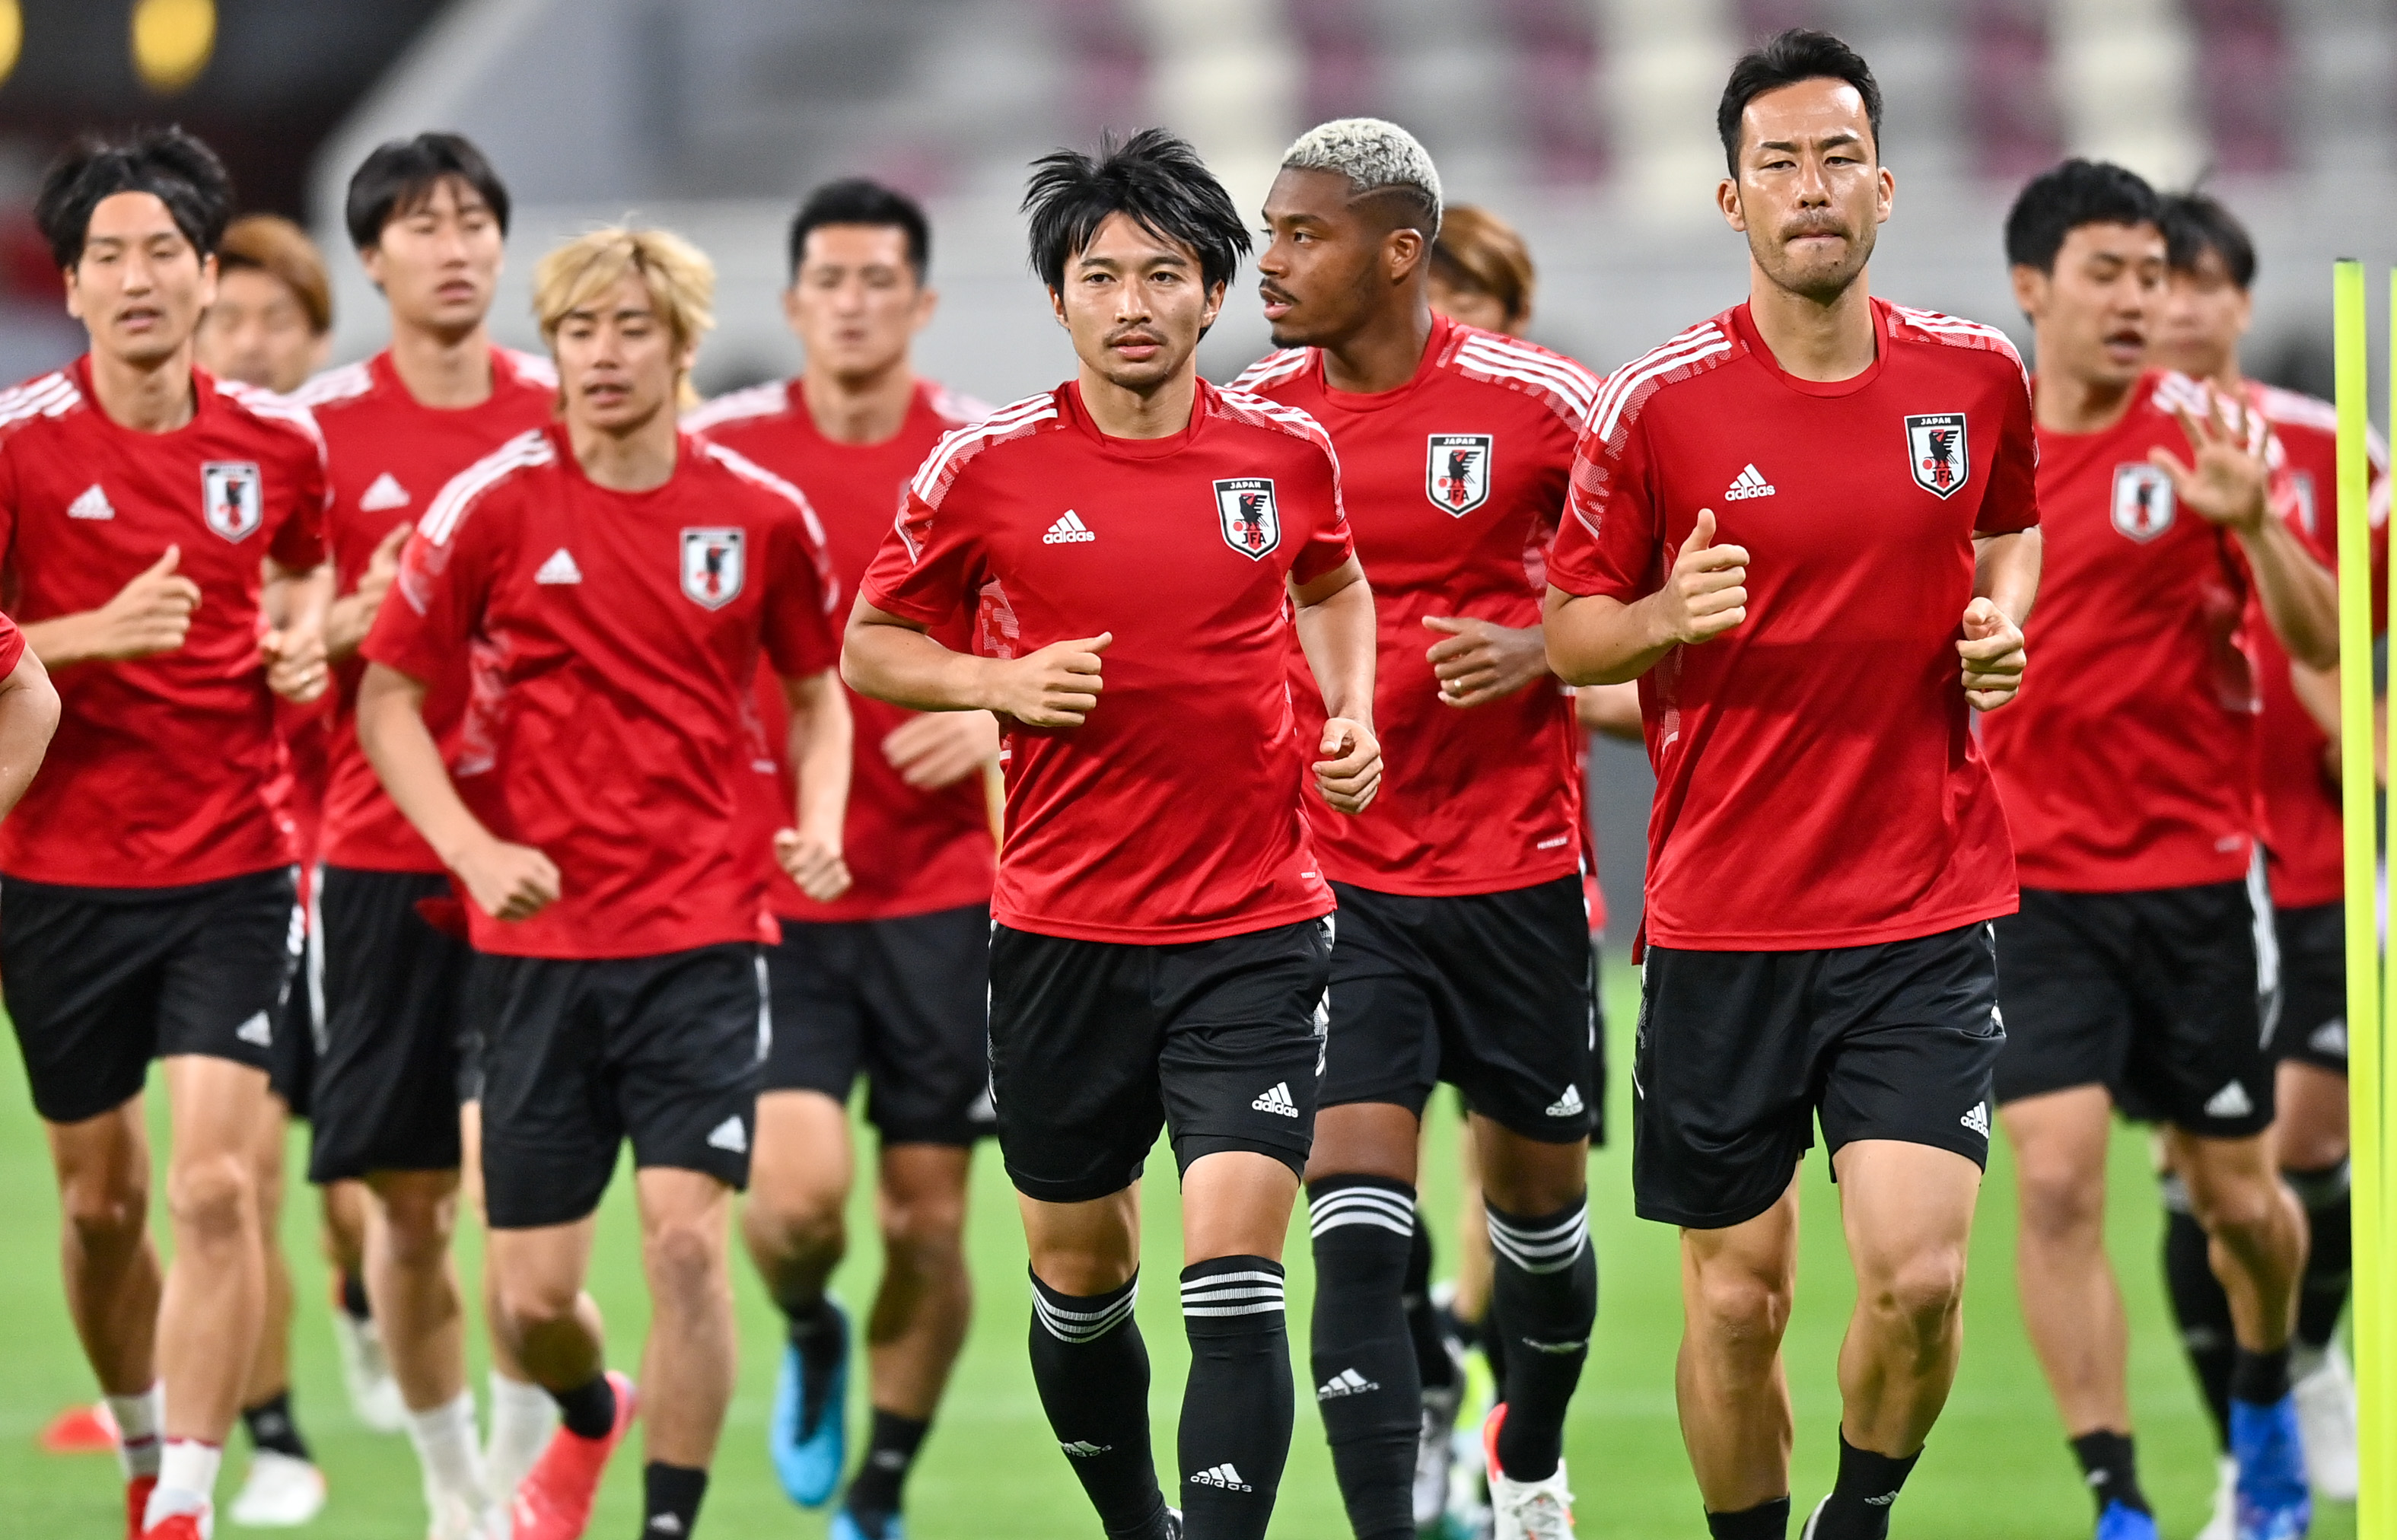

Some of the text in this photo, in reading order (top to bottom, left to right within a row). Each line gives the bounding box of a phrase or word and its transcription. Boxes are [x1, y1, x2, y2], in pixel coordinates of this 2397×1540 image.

[1920, 417, 1952, 425] JAPAN
[1930, 469, 1955, 483] JFA
[1230, 481, 1262, 489] JAPAN
[1444, 489, 1470, 501] JFA
[1724, 485, 1776, 501] adidas
[1042, 530, 1096, 545] adidas
[1241, 532, 1267, 544] JFA
[1251, 1099, 1299, 1118] adidas
[1960, 1115, 1989, 1139] adida
[1189, 1475, 1253, 1493] adidas
